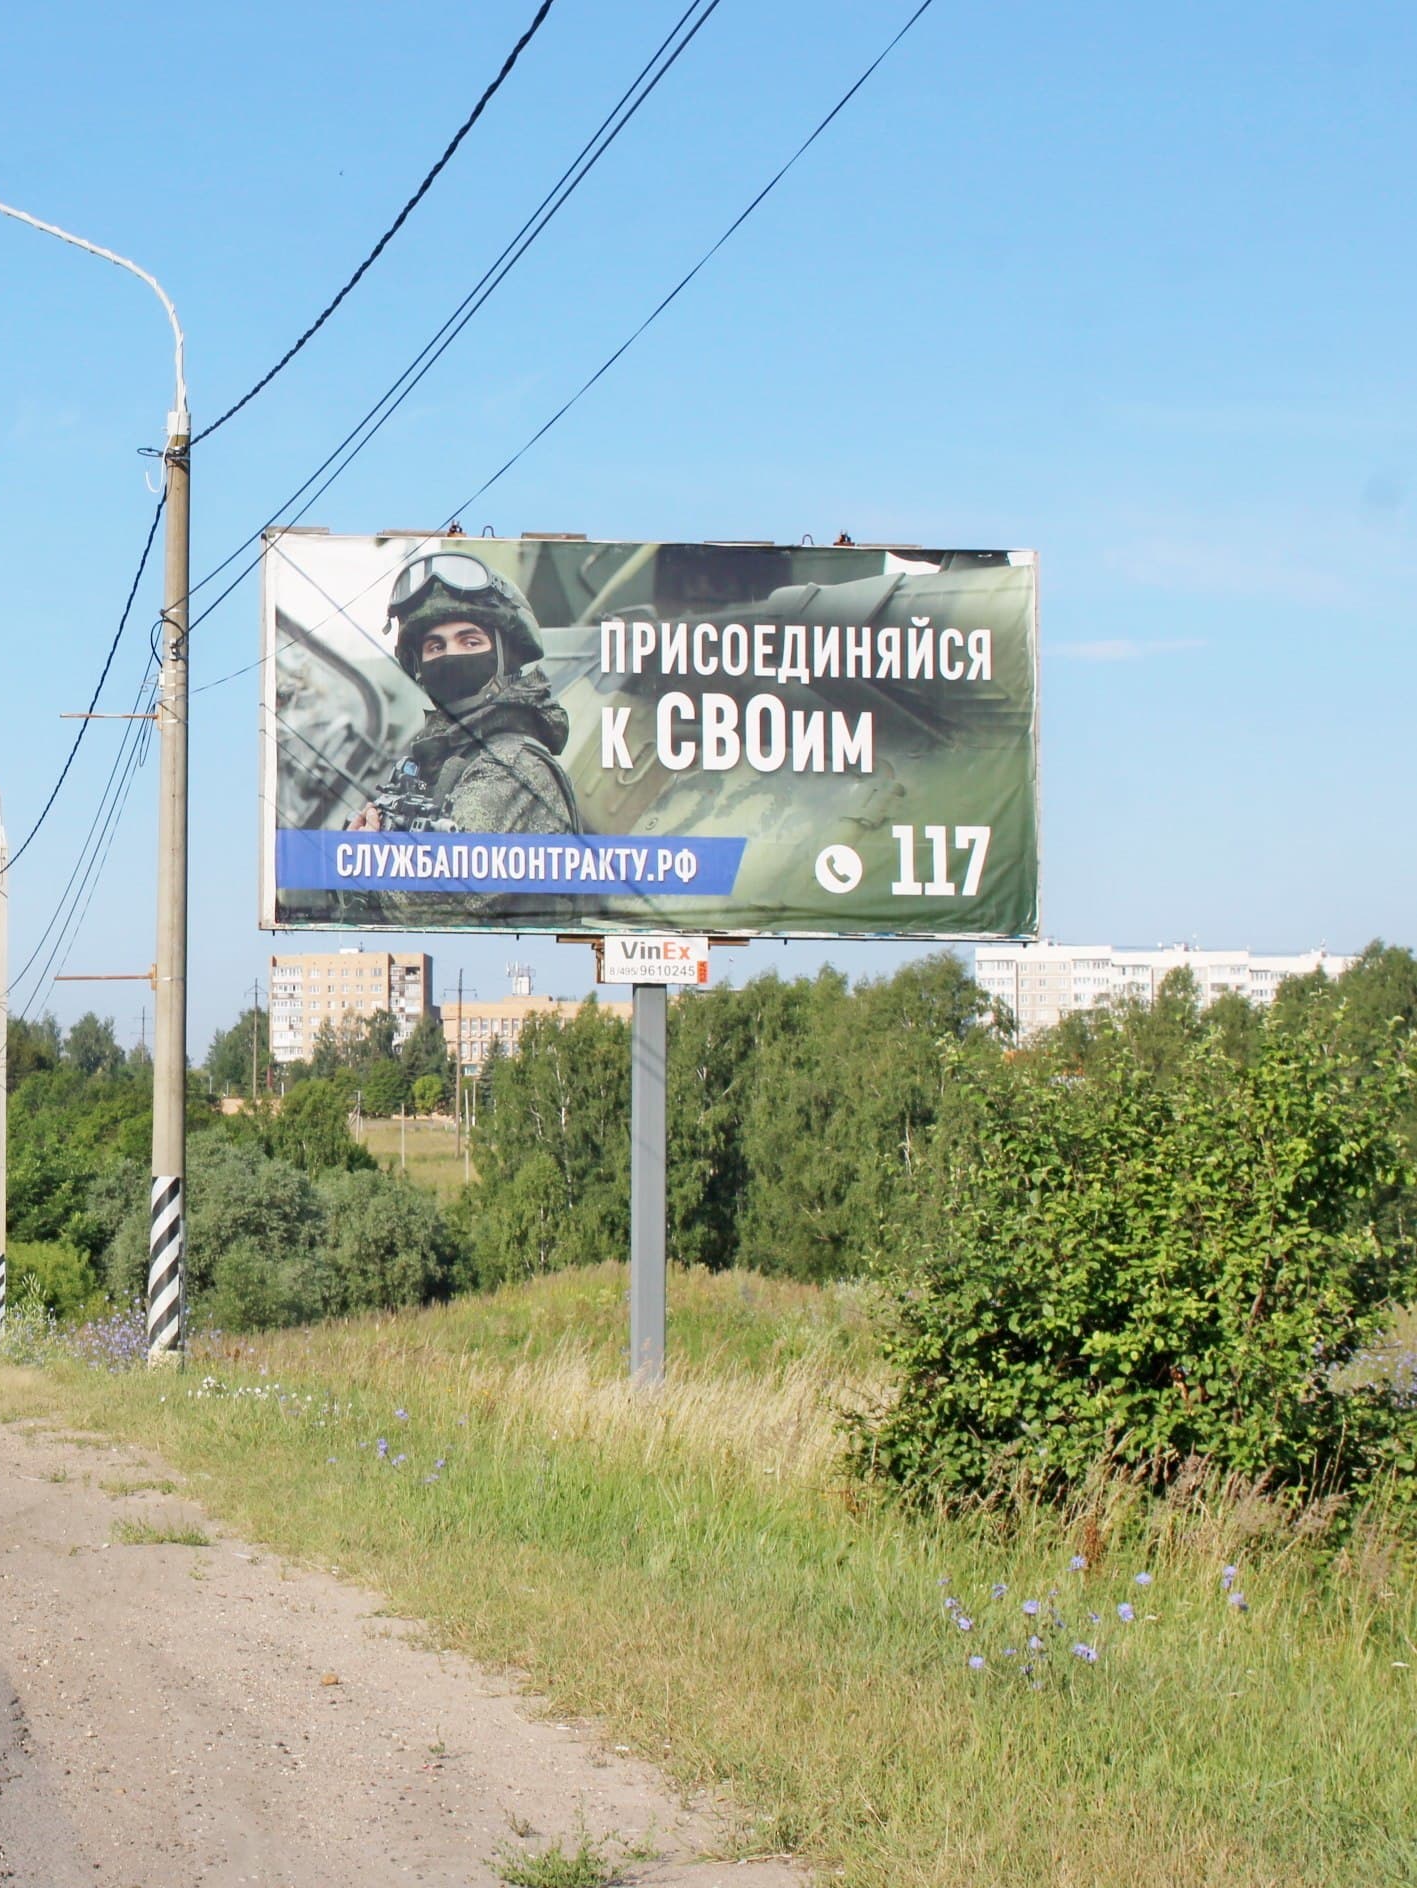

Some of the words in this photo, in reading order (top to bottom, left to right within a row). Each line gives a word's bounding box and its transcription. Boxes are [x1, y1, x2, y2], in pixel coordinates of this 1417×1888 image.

[600, 615, 992, 684] ПРИСОЕДИНЯЙСЯ
[336, 842, 698, 884] СЛУЖБАПОКОНТРАКТУ.РФ
[891, 824, 991, 896] 117
[621, 940, 690, 960] VinEx
